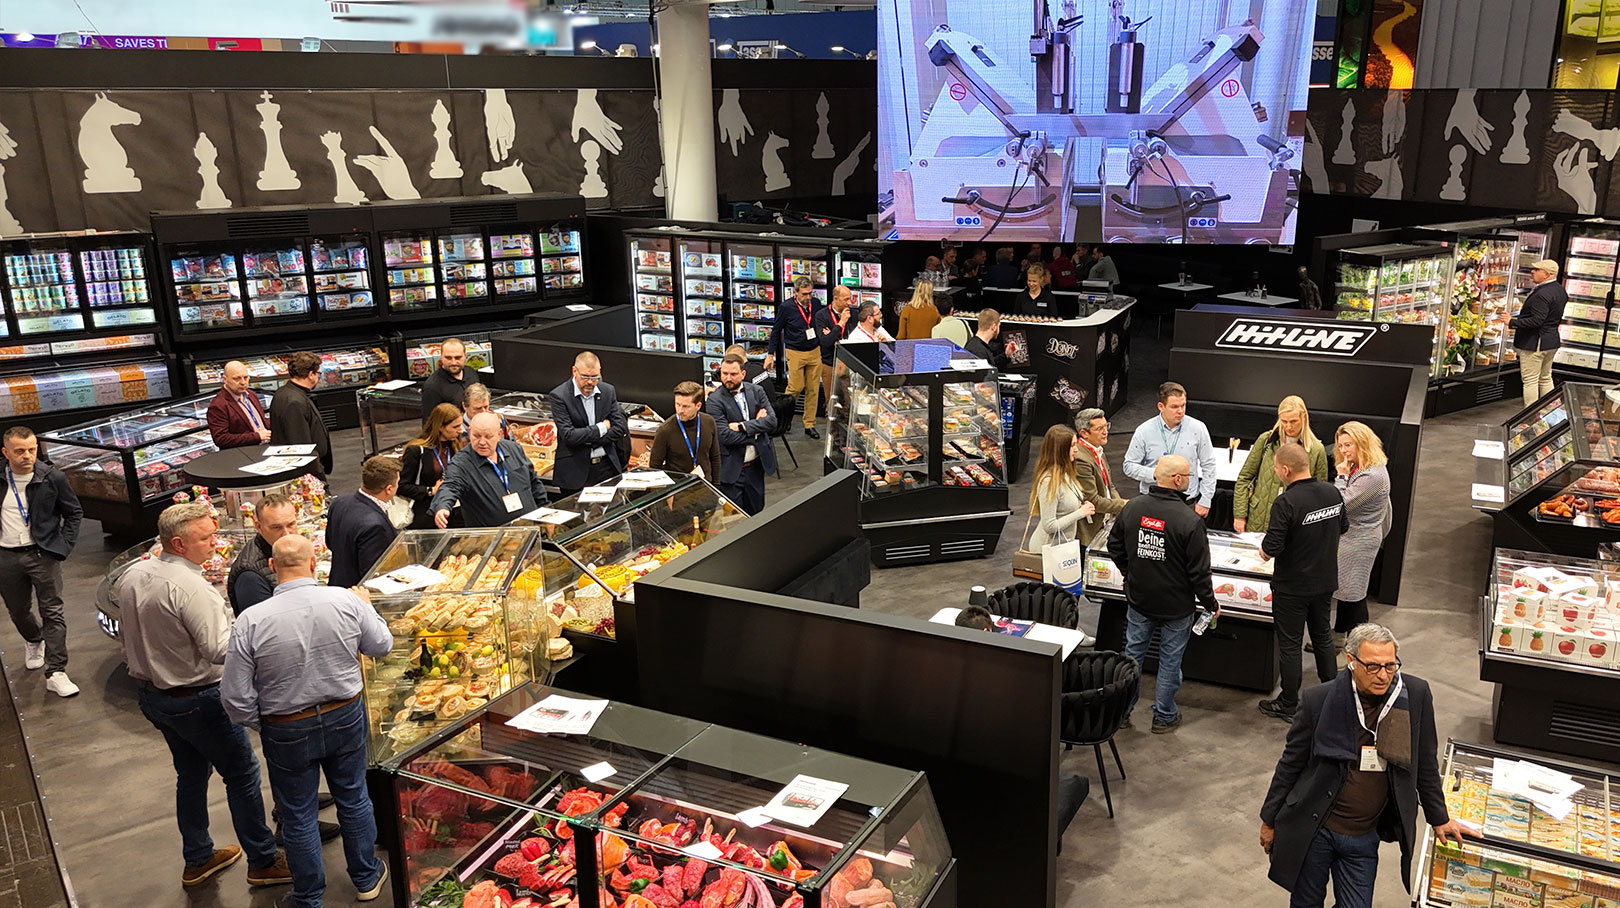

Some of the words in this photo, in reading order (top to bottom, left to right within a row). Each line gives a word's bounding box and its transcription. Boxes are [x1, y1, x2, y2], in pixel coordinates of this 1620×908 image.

[115, 38, 154, 48] SAVES
[1138, 530, 1165, 547] Deine
[1505, 877, 1531, 888] МАСЛО
[1503, 896, 1529, 908] МАСЛО
